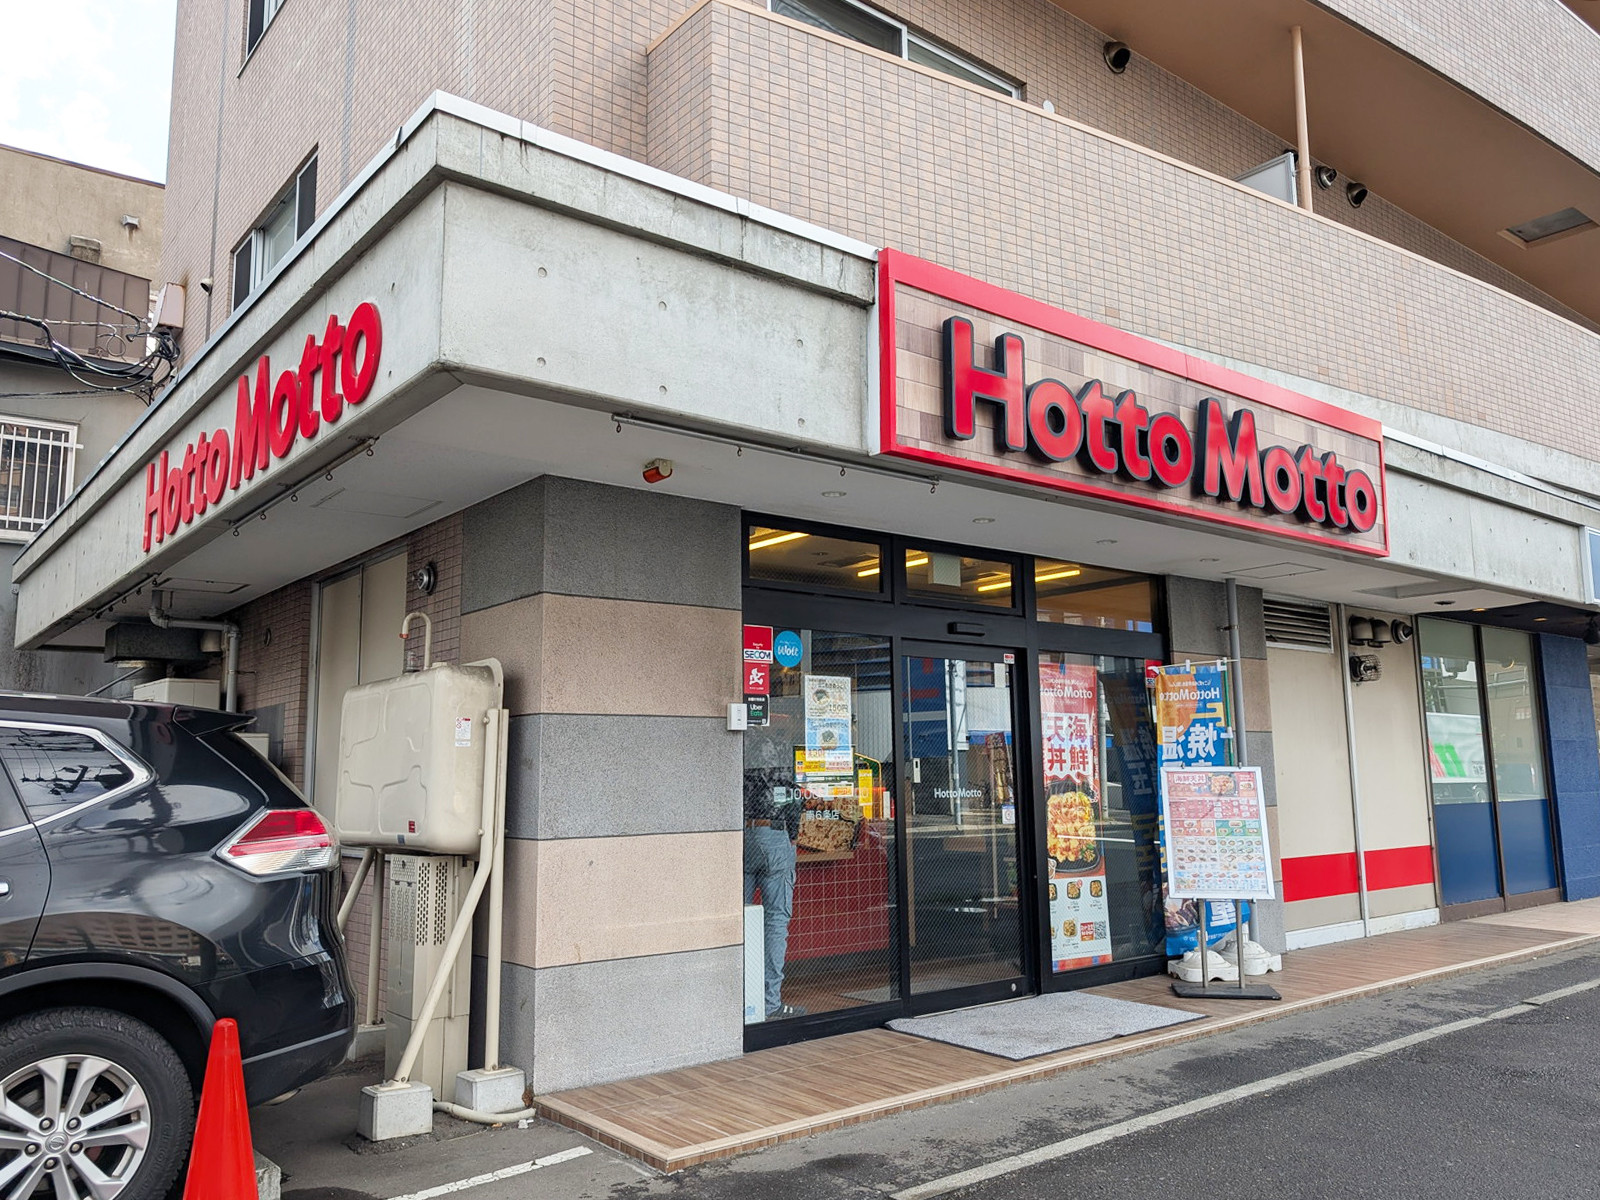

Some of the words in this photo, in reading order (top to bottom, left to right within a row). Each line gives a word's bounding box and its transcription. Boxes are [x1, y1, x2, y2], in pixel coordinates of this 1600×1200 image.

[744, 650, 772, 660] SECOM
[777, 645, 799, 657] Wolt
[1047, 715, 1067, 772] 天丼
[1068, 715, 1089, 772] 海鮮
